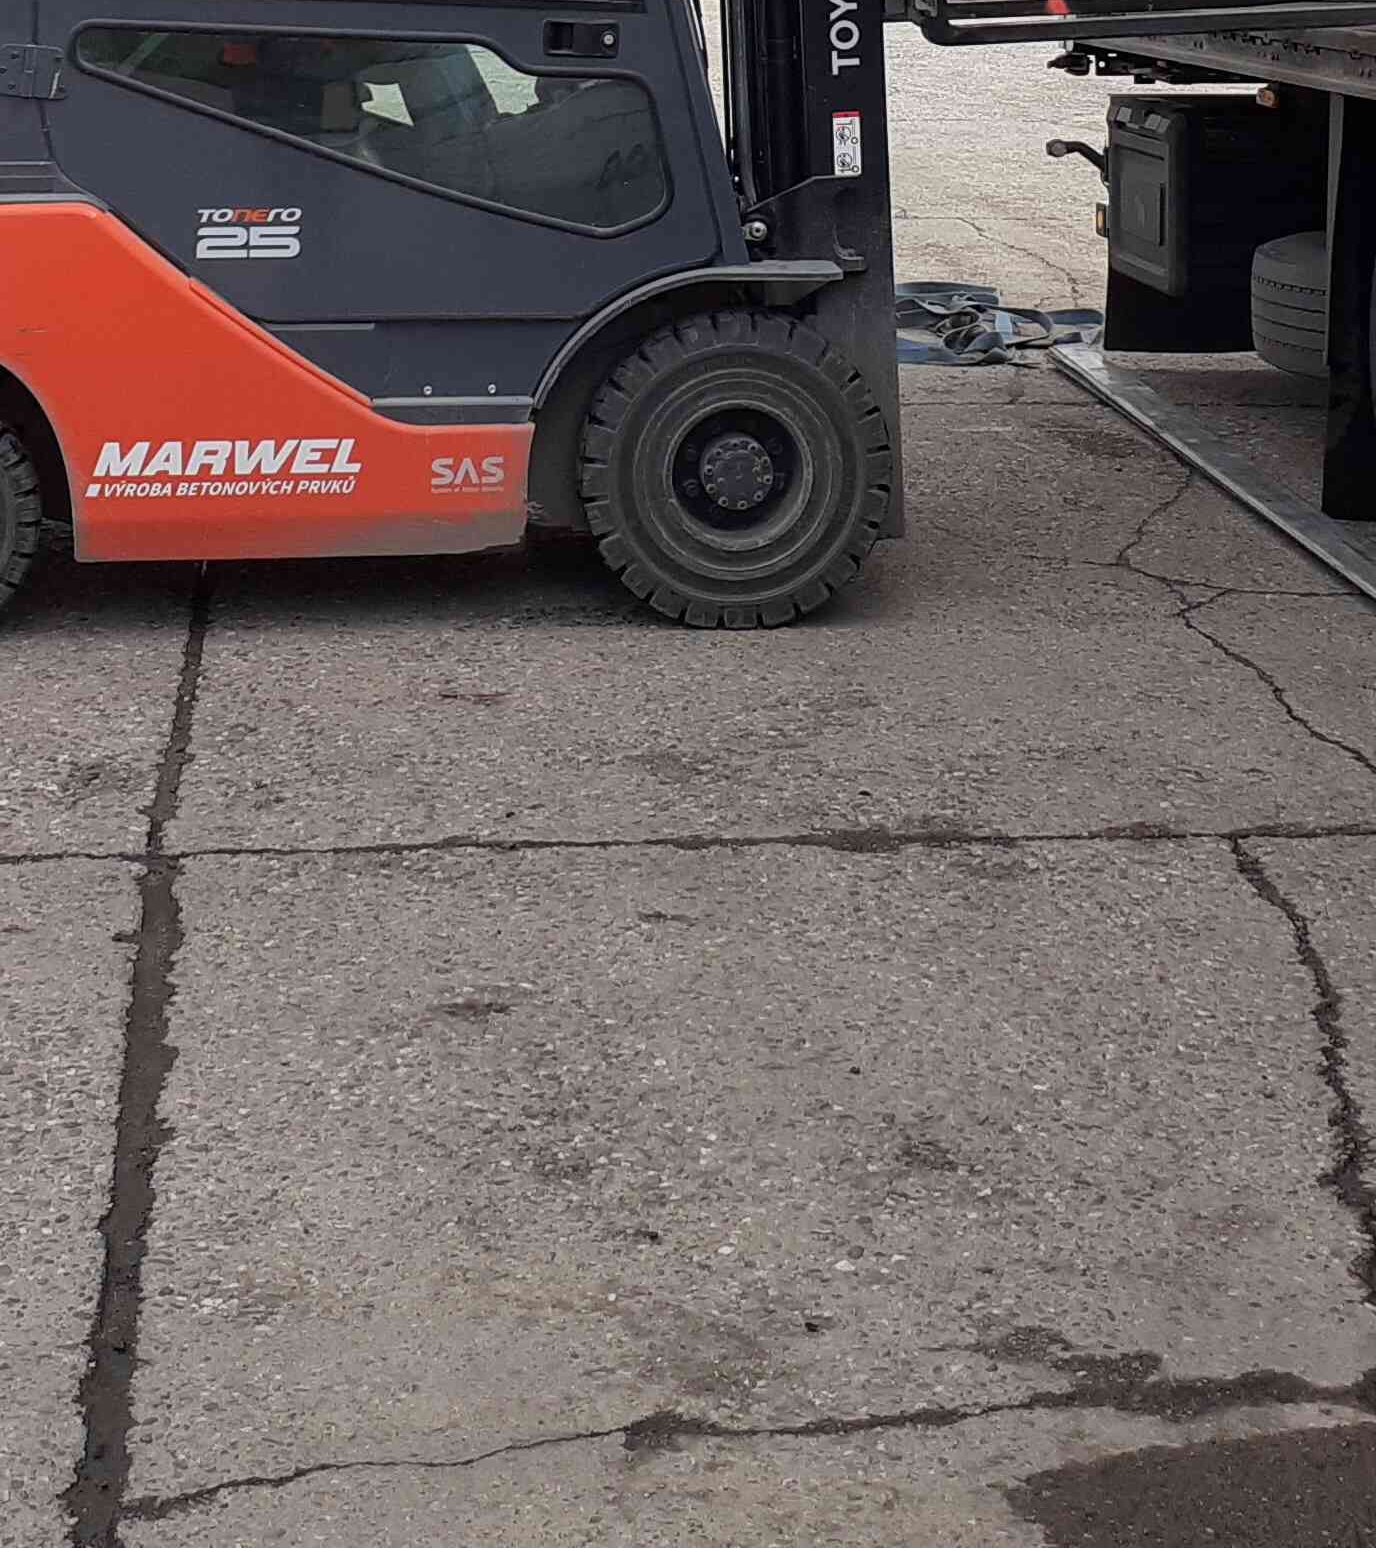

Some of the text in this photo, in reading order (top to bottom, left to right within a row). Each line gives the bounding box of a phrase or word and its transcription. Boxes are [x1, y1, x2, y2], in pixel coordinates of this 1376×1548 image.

[195, 225, 301, 259] 25
[92, 438, 363, 477] MARWEL
[431, 456, 505, 485] SAS
[103, 475, 356, 498] VÝROBA BETONOVÝCH PRVKŮ
